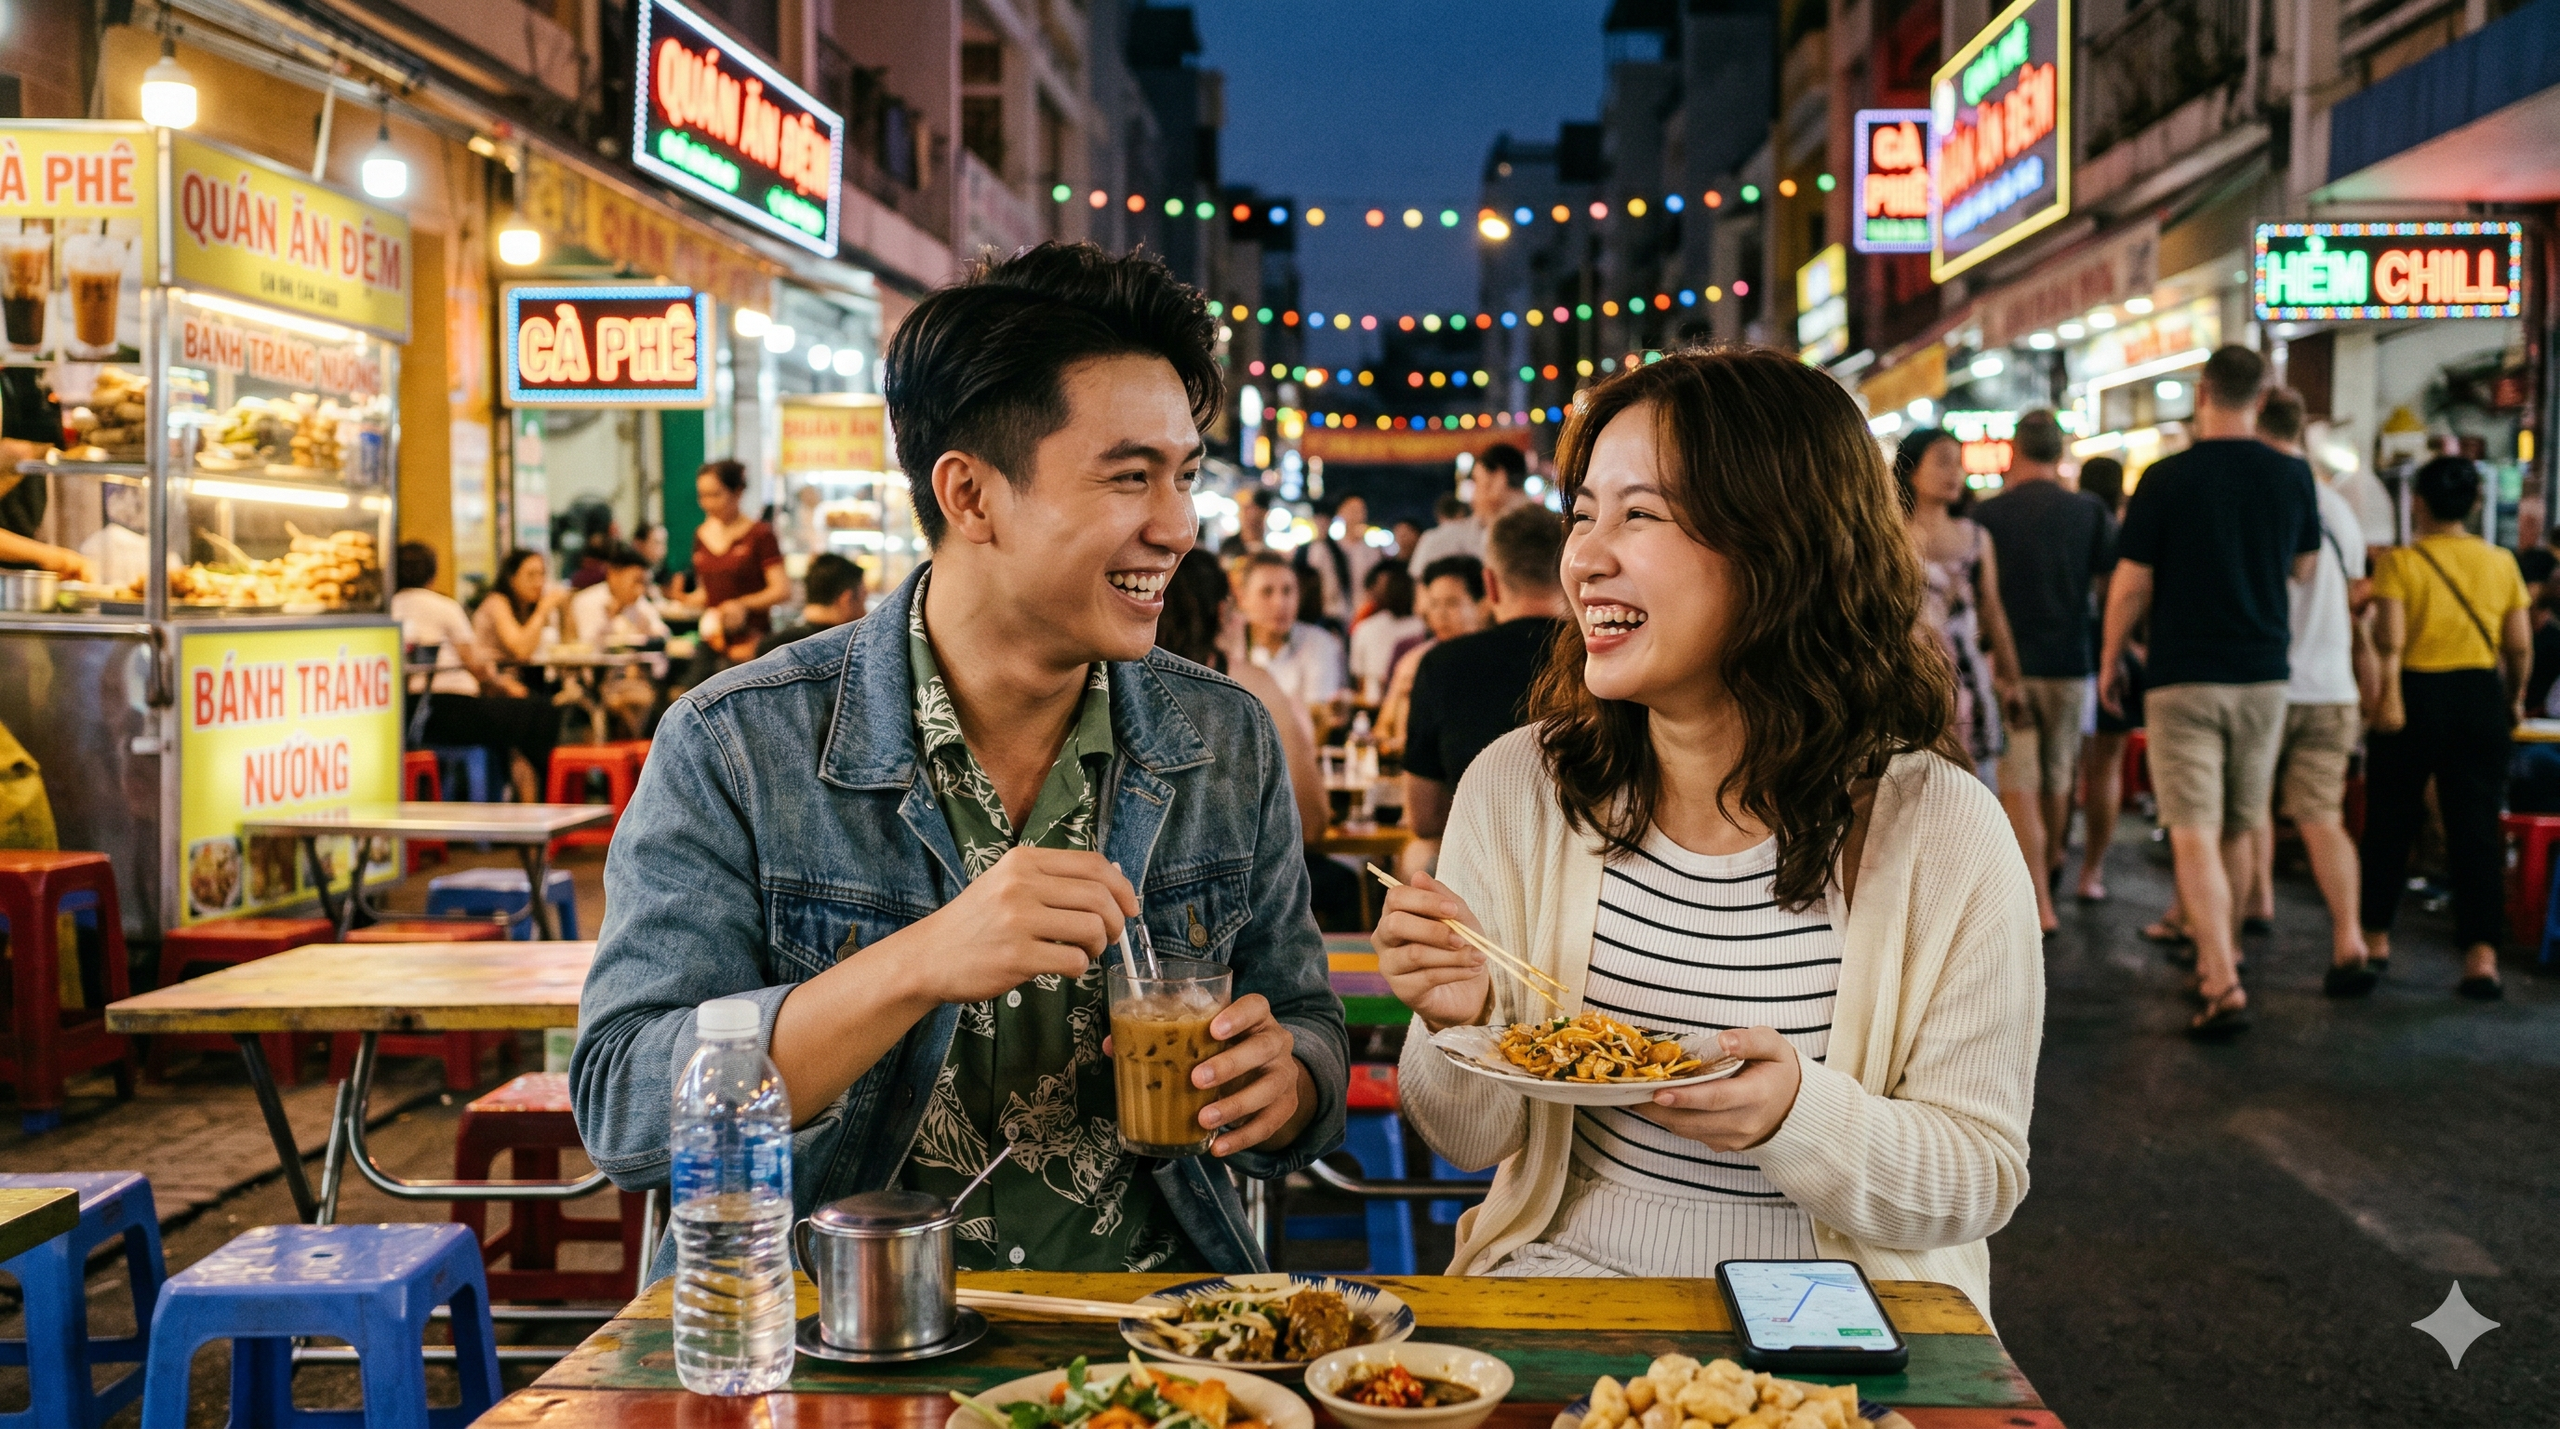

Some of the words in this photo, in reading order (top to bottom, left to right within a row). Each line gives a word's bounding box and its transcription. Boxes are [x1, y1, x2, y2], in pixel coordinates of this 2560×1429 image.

[46, 142, 134, 203] PHÊ
[183, 174, 277, 256] QUÁN
[289, 197, 330, 269] ĂN
[2375, 249, 2508, 305] CHILL
[518, 303, 591, 383] CÀ
[596, 303, 698, 383] PHÊ
[195, 653, 285, 727] BÁNH
[298, 647, 390, 714] TRÁNG
